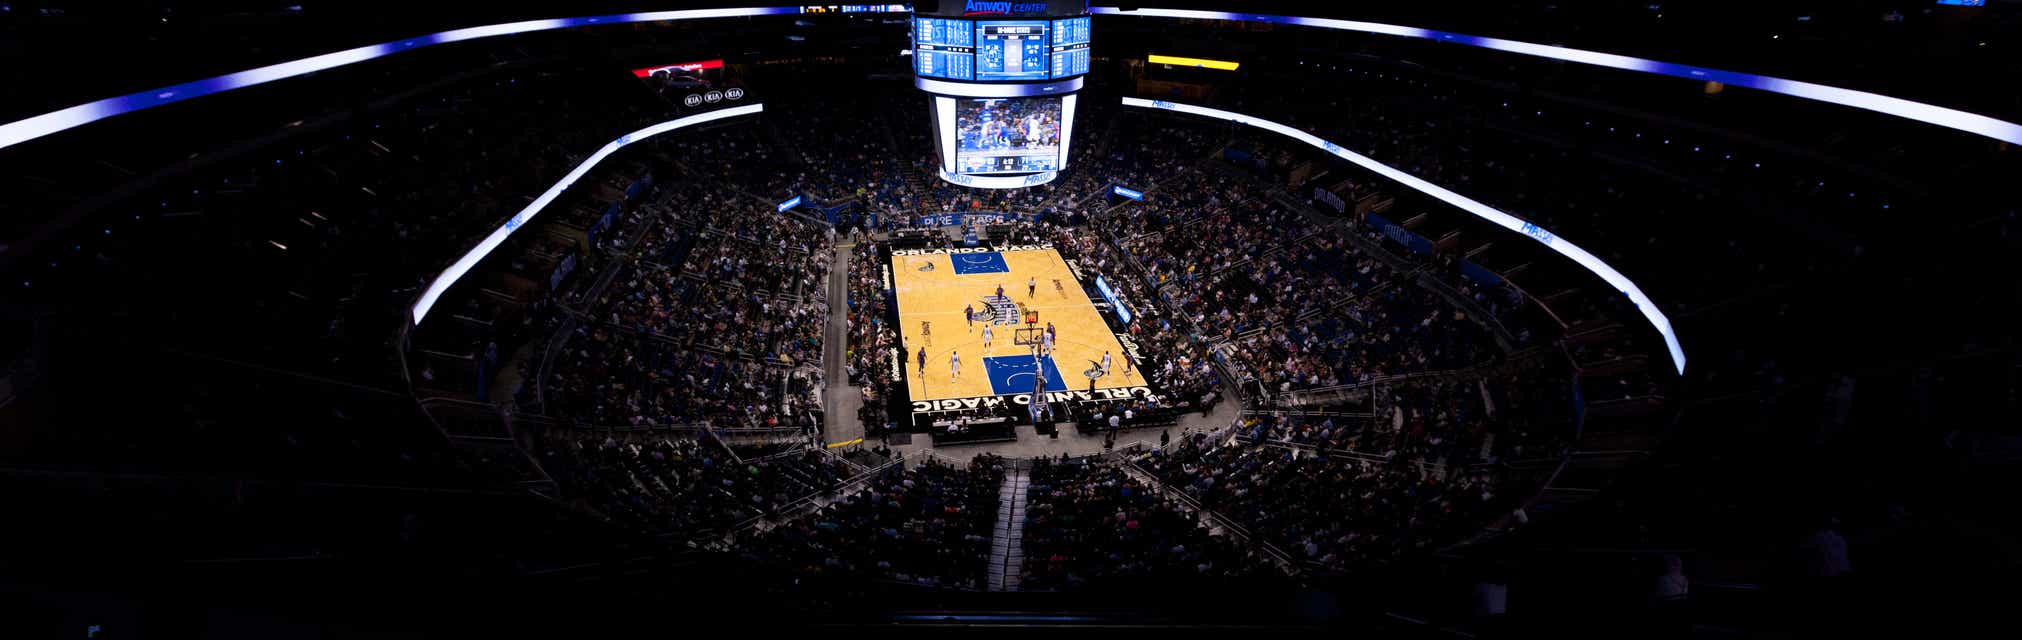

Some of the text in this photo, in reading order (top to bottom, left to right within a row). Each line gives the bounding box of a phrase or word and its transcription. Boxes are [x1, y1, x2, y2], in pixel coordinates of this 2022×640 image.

[965, 0, 1047, 14] Amway CENTER
[892, 243, 1055, 257] ORLANDO MAGIC
